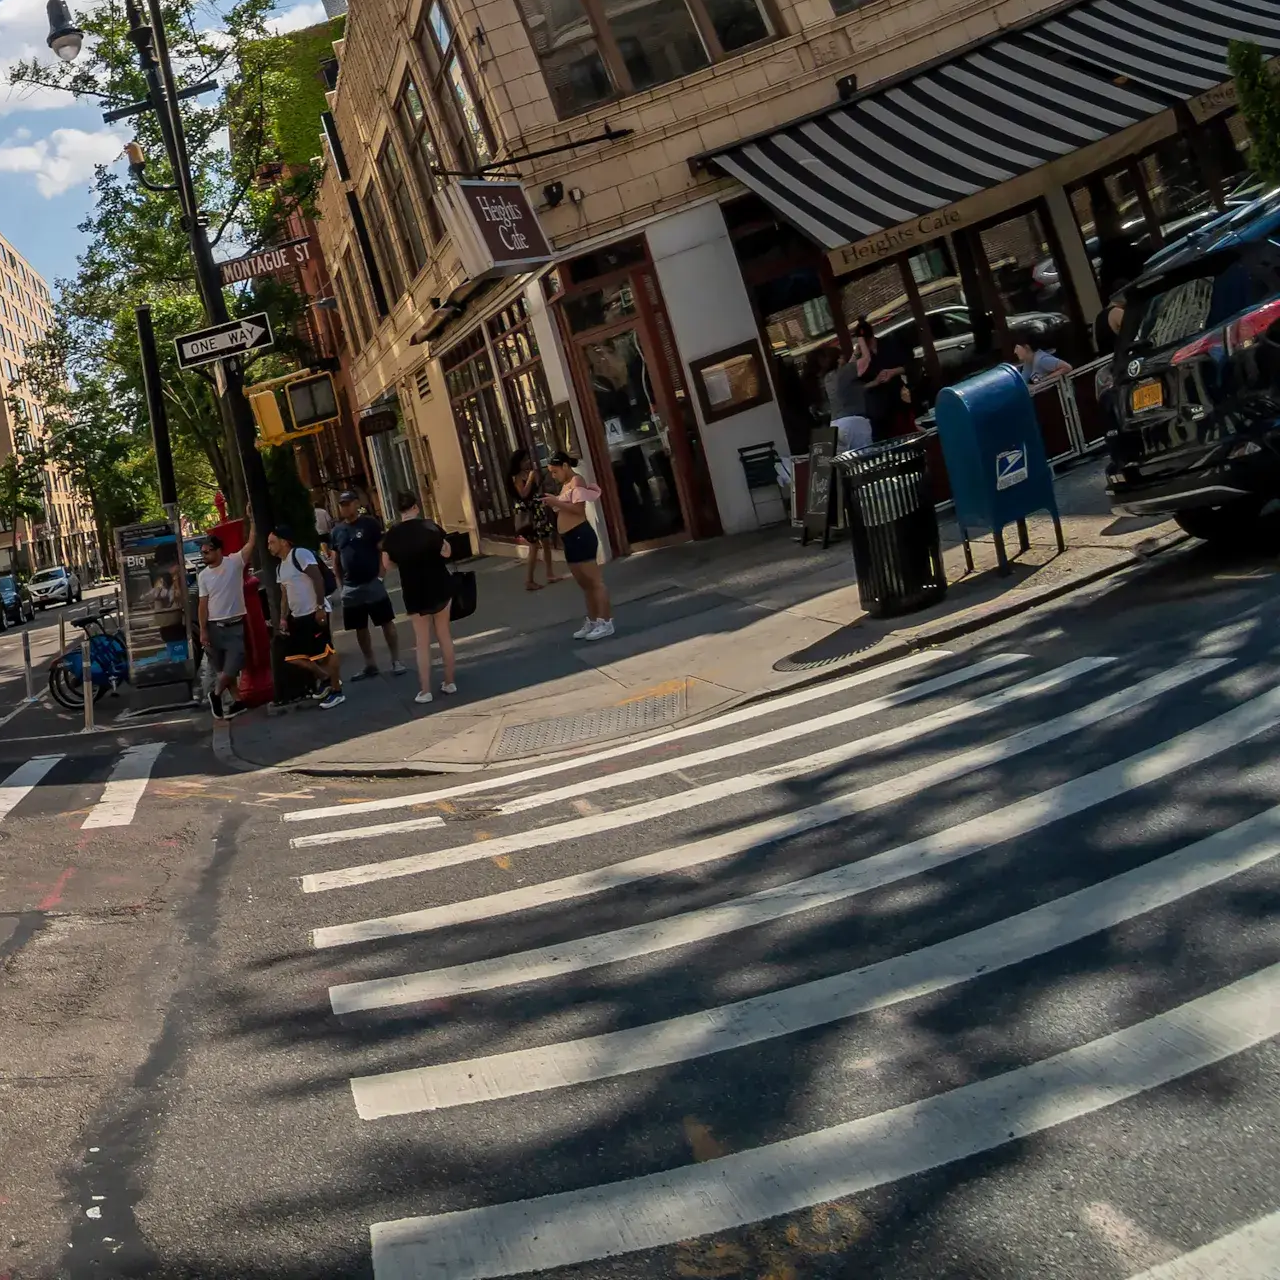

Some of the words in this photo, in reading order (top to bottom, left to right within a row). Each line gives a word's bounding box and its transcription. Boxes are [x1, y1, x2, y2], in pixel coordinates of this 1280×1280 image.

[476, 195, 523, 227] Heights
[498, 223, 530, 251] Cafe
[840, 227, 914, 265] Heights
[917, 208, 961, 234] Cafe
[223, 248, 290, 283] MONTAGUE
[293, 242, 311, 262] ST
[190, 337, 218, 355] ONE
[227, 326, 255, 345] WAY
[126, 555, 146, 568] Big
